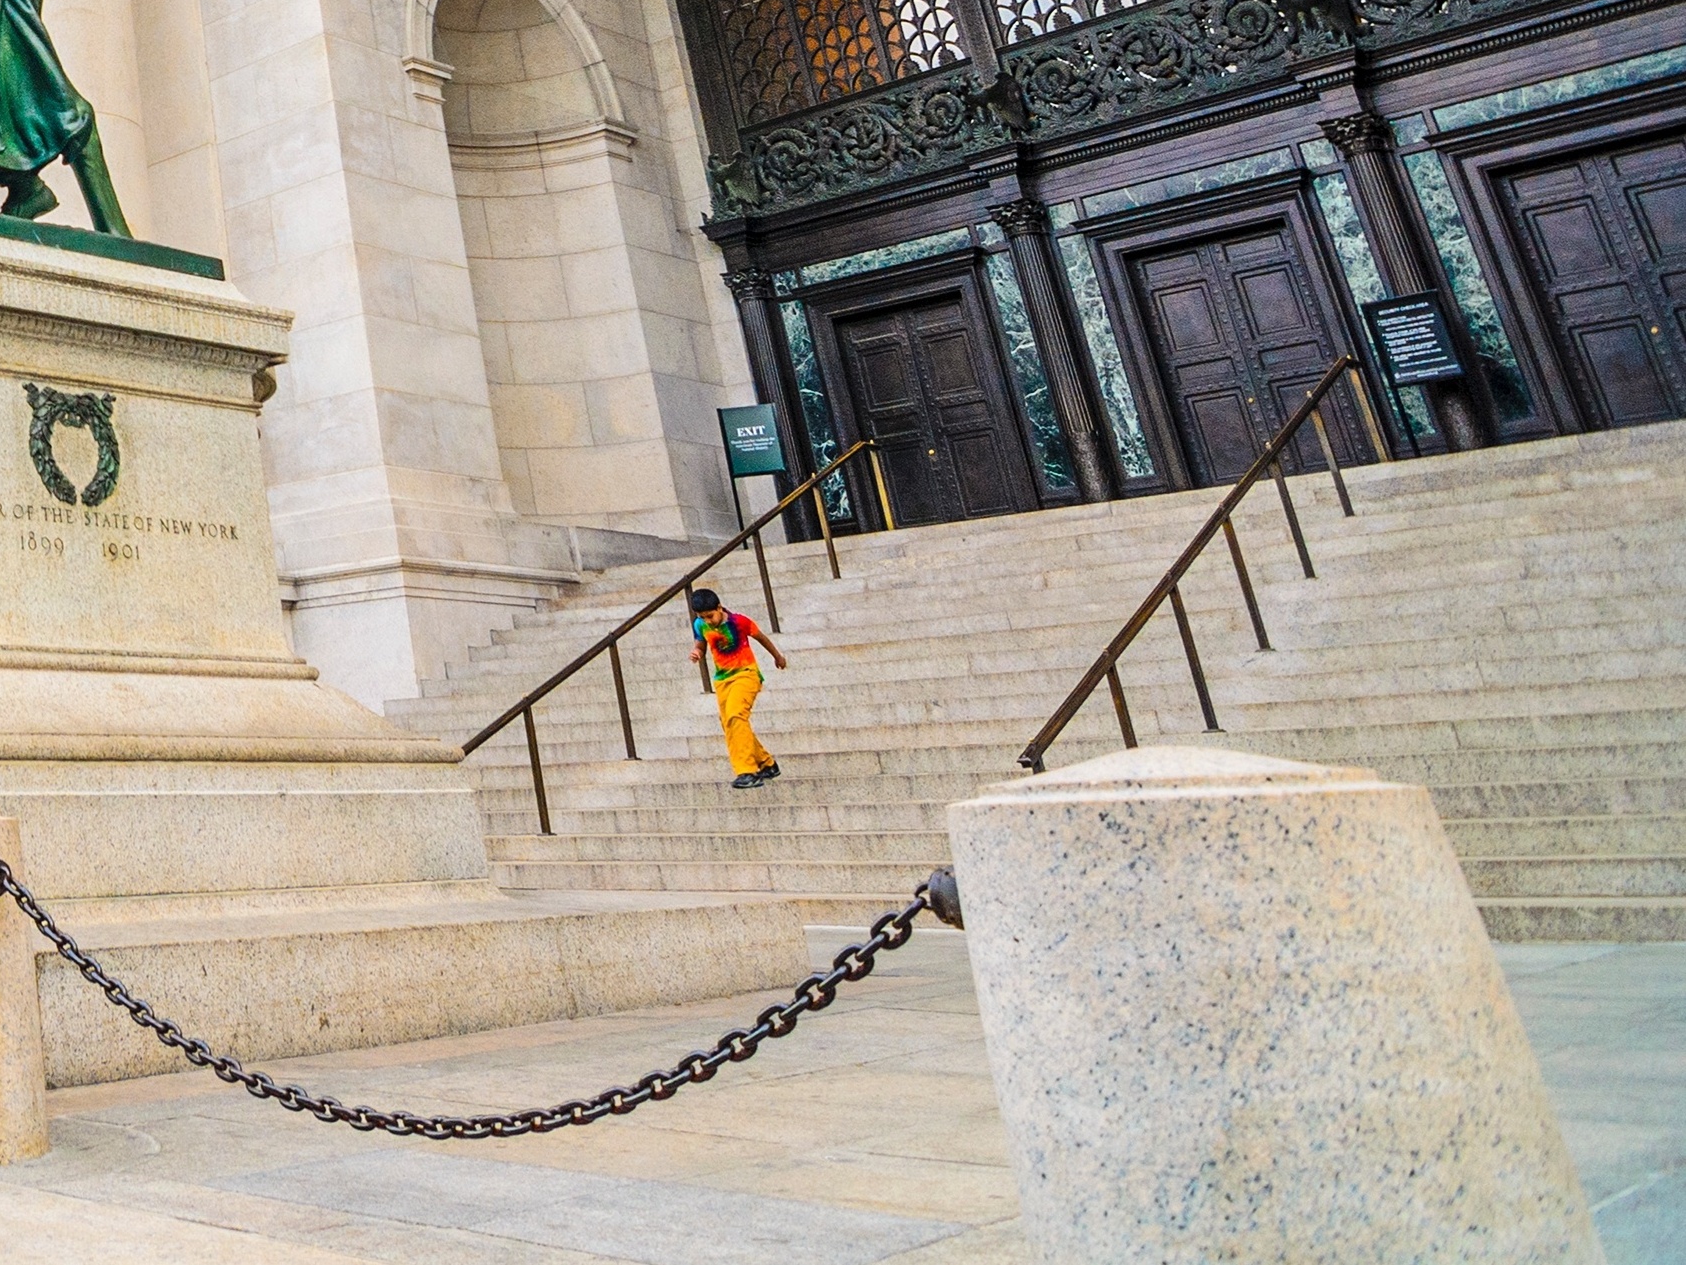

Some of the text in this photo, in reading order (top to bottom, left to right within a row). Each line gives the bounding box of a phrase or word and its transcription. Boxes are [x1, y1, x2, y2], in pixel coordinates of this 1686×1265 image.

[736, 425, 766, 437] EXIT
[13, 504, 35, 521] OF
[41, 506, 75, 524] THE
[84, 511, 129, 531] STATE
[133, 515, 156, 532] OF
[160, 519, 193, 535] NEW
[198, 522, 240, 541] YORK
[20, 530, 141, 561] 1899 1901
